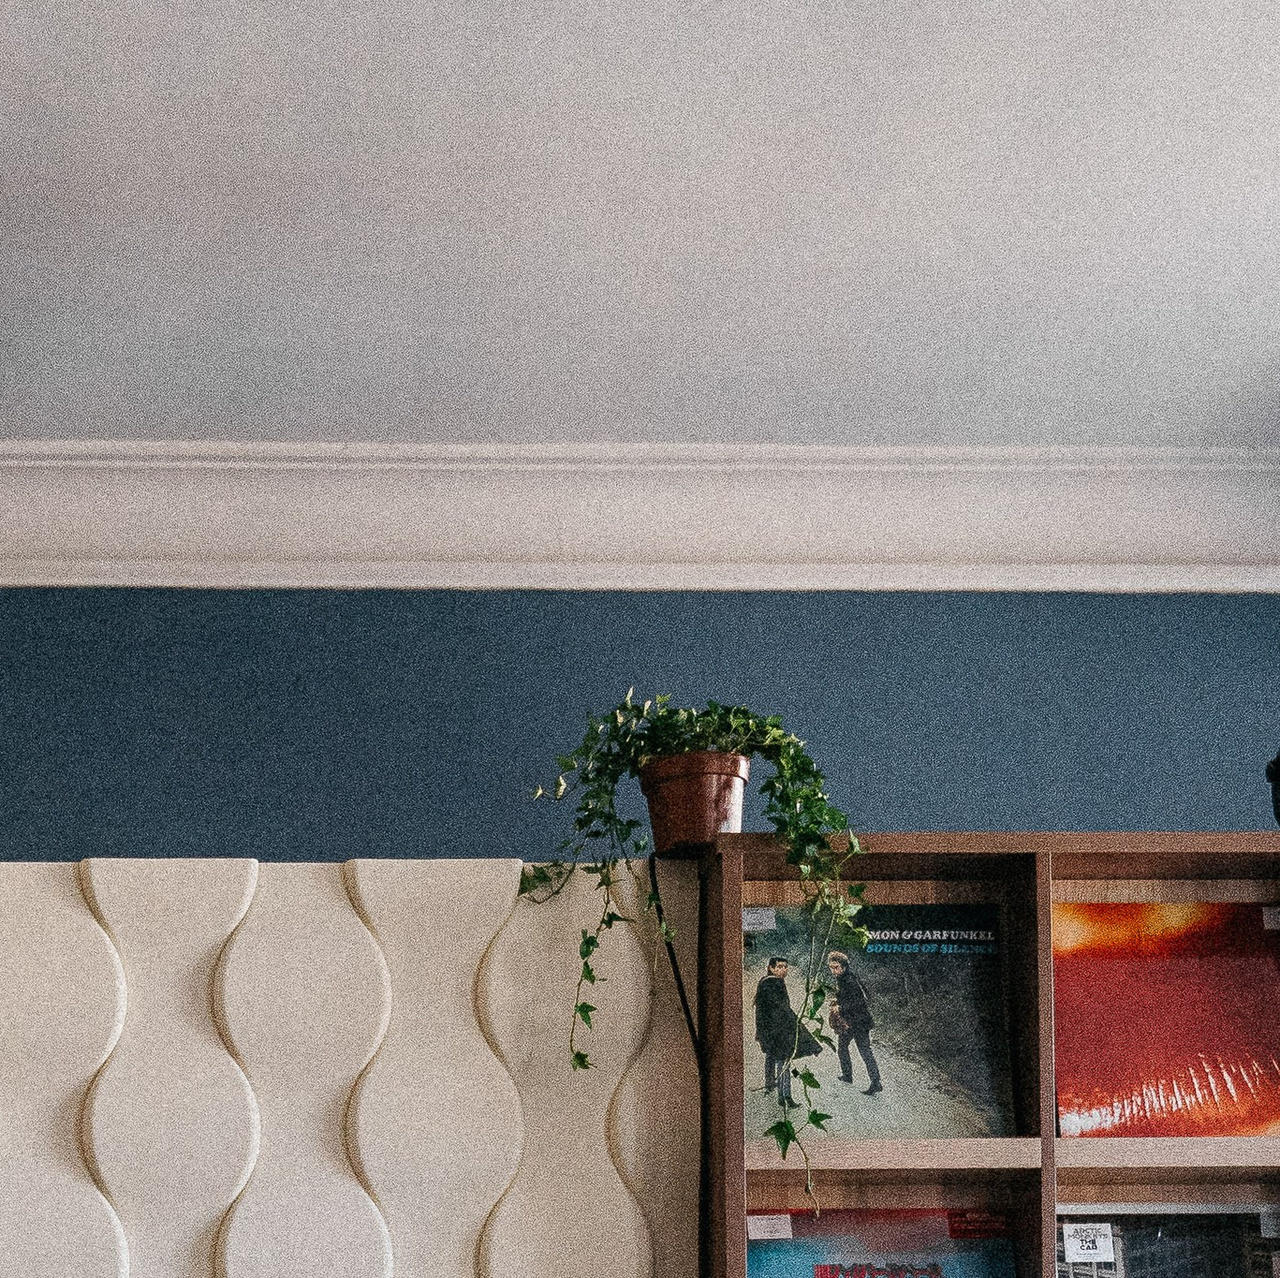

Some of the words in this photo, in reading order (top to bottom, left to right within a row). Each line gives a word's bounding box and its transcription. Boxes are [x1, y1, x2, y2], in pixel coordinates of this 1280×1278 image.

[914, 930, 995, 940] GARFUNKEL
[866, 944, 919, 953] SOUNDS
[922, 944, 938, 953] OF
